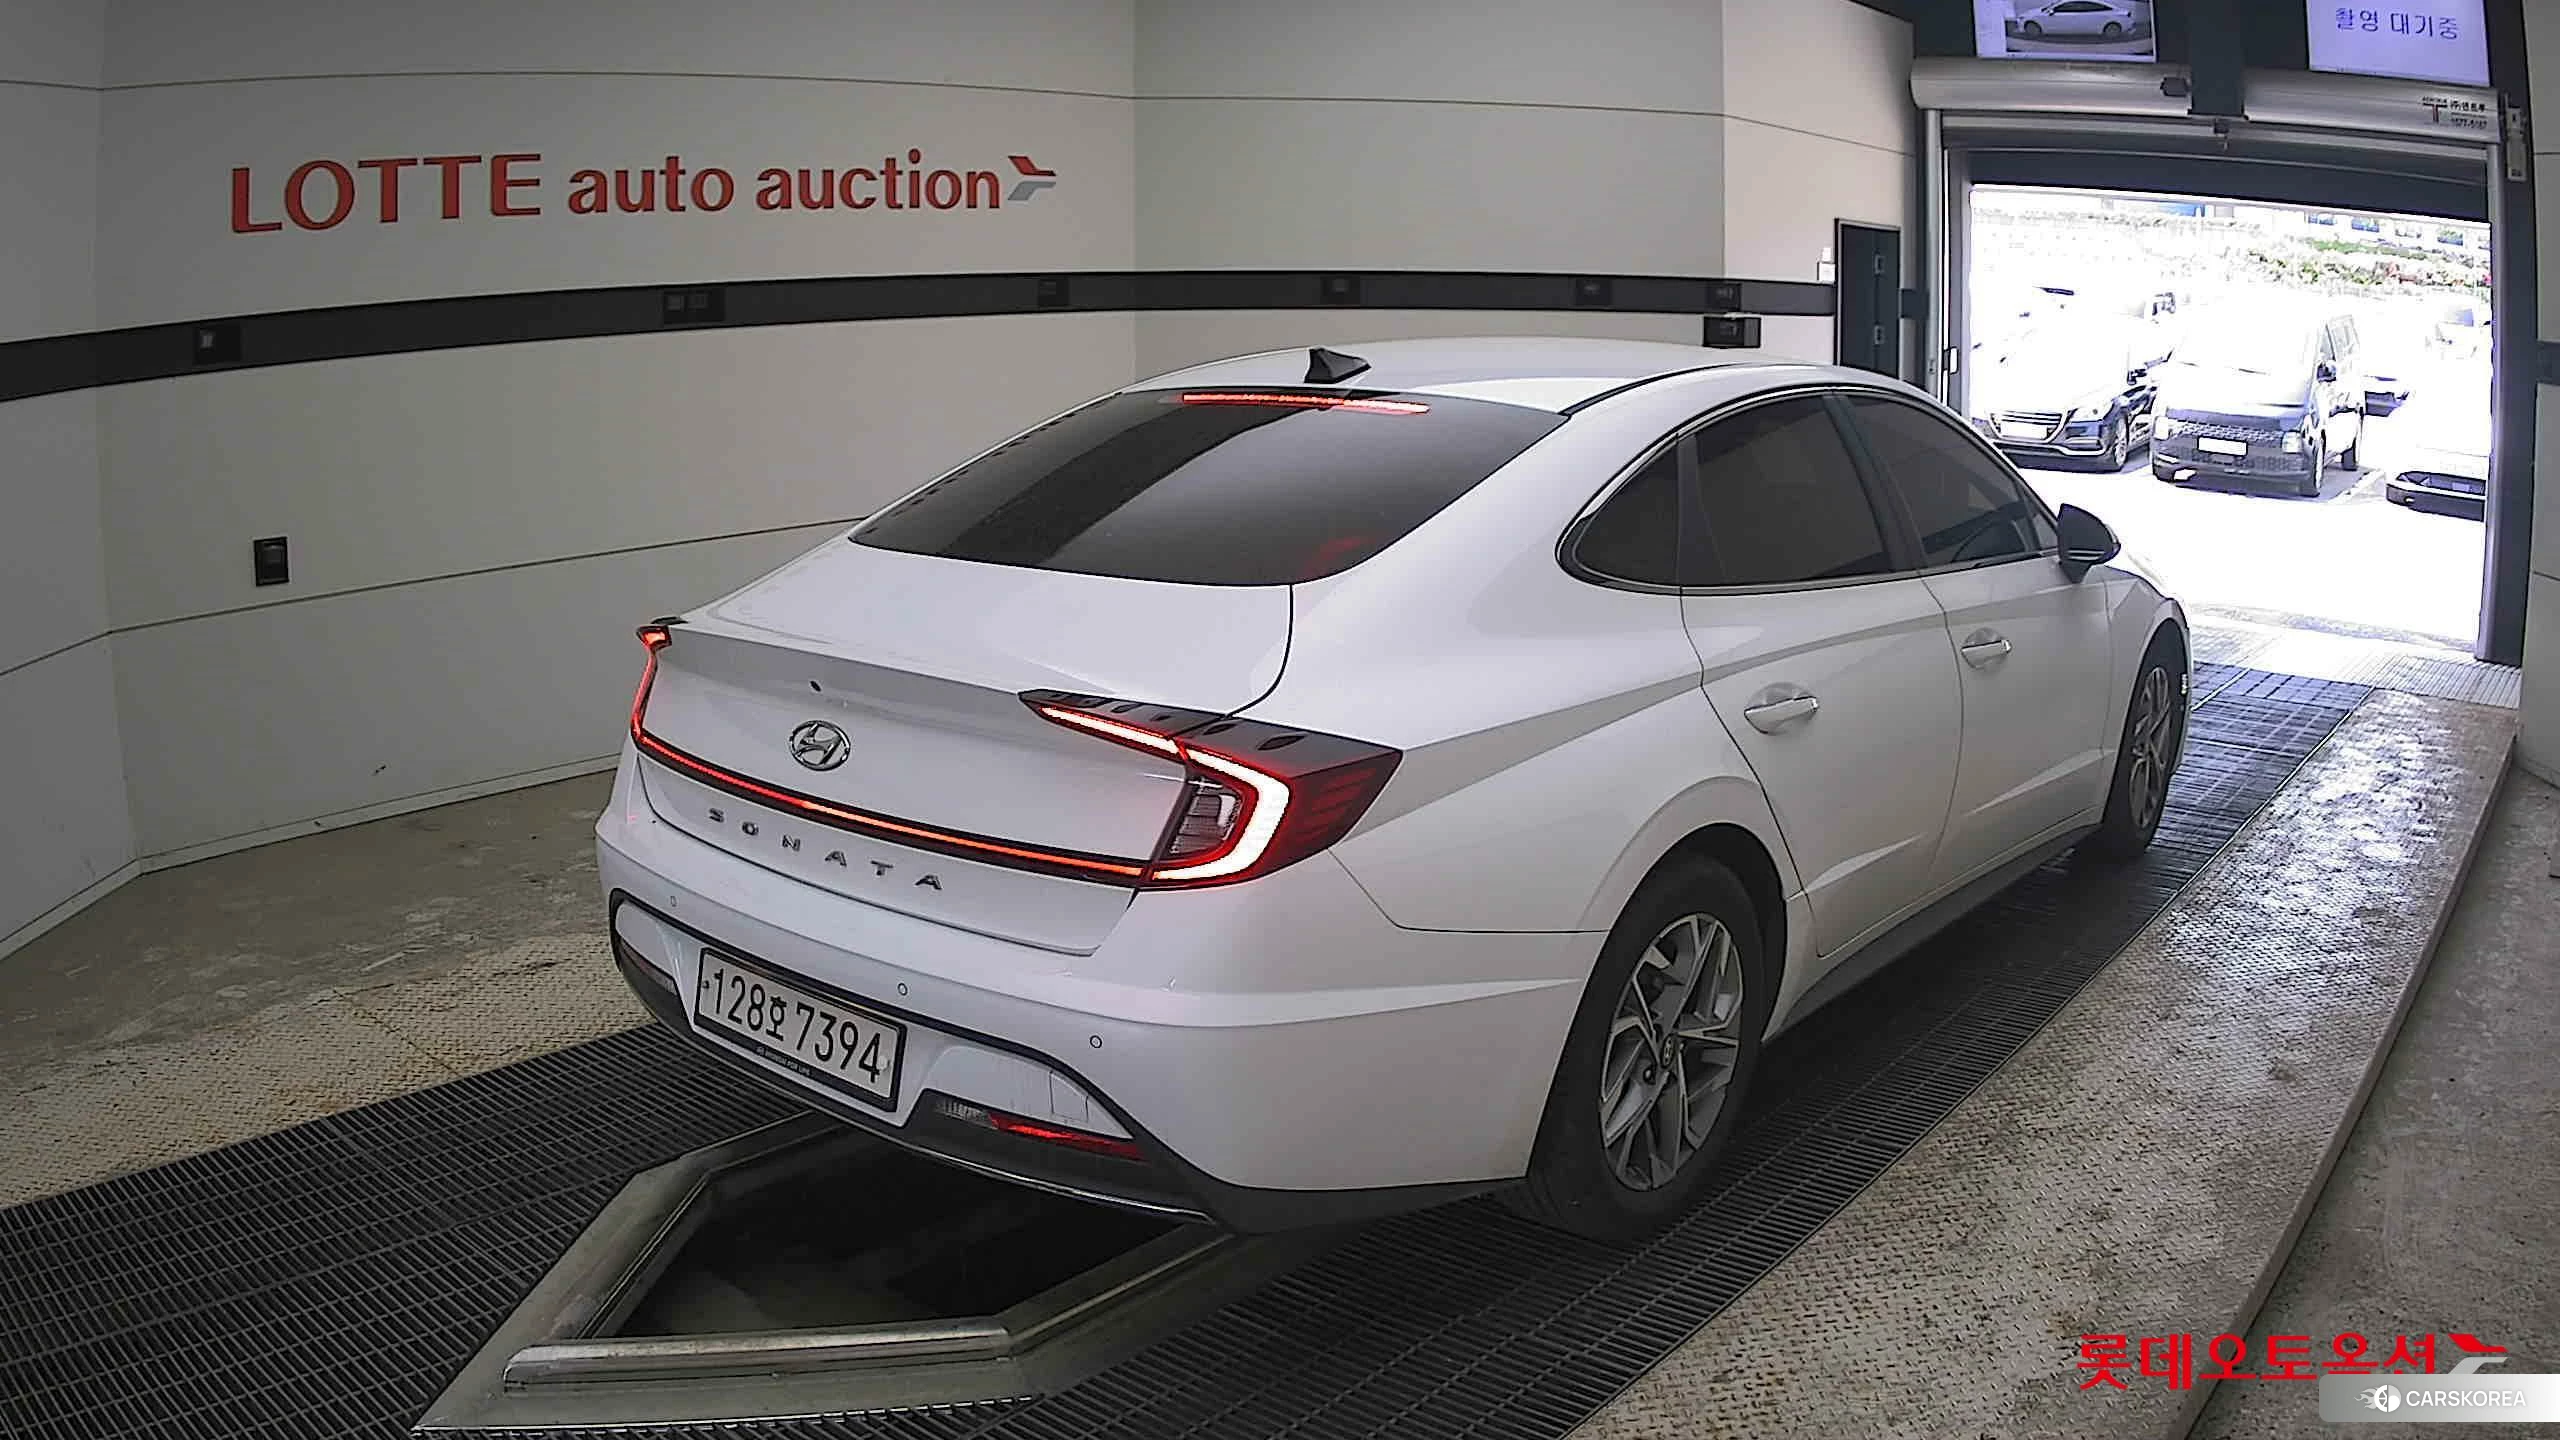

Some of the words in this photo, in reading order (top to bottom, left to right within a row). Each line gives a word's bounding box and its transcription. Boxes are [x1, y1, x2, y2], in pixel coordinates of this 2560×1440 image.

[2335, 7, 2379, 33] 촬영
[2390, 12, 2458, 40] 대기중
[231, 153, 541, 233] LOTTE
[567, 155, 734, 214] auto
[755, 148, 1001, 210] auction
[708, 807, 943, 891] SONATA
[714, 968, 788, 1042] 128호
[796, 1001, 881, 1084] 7394
